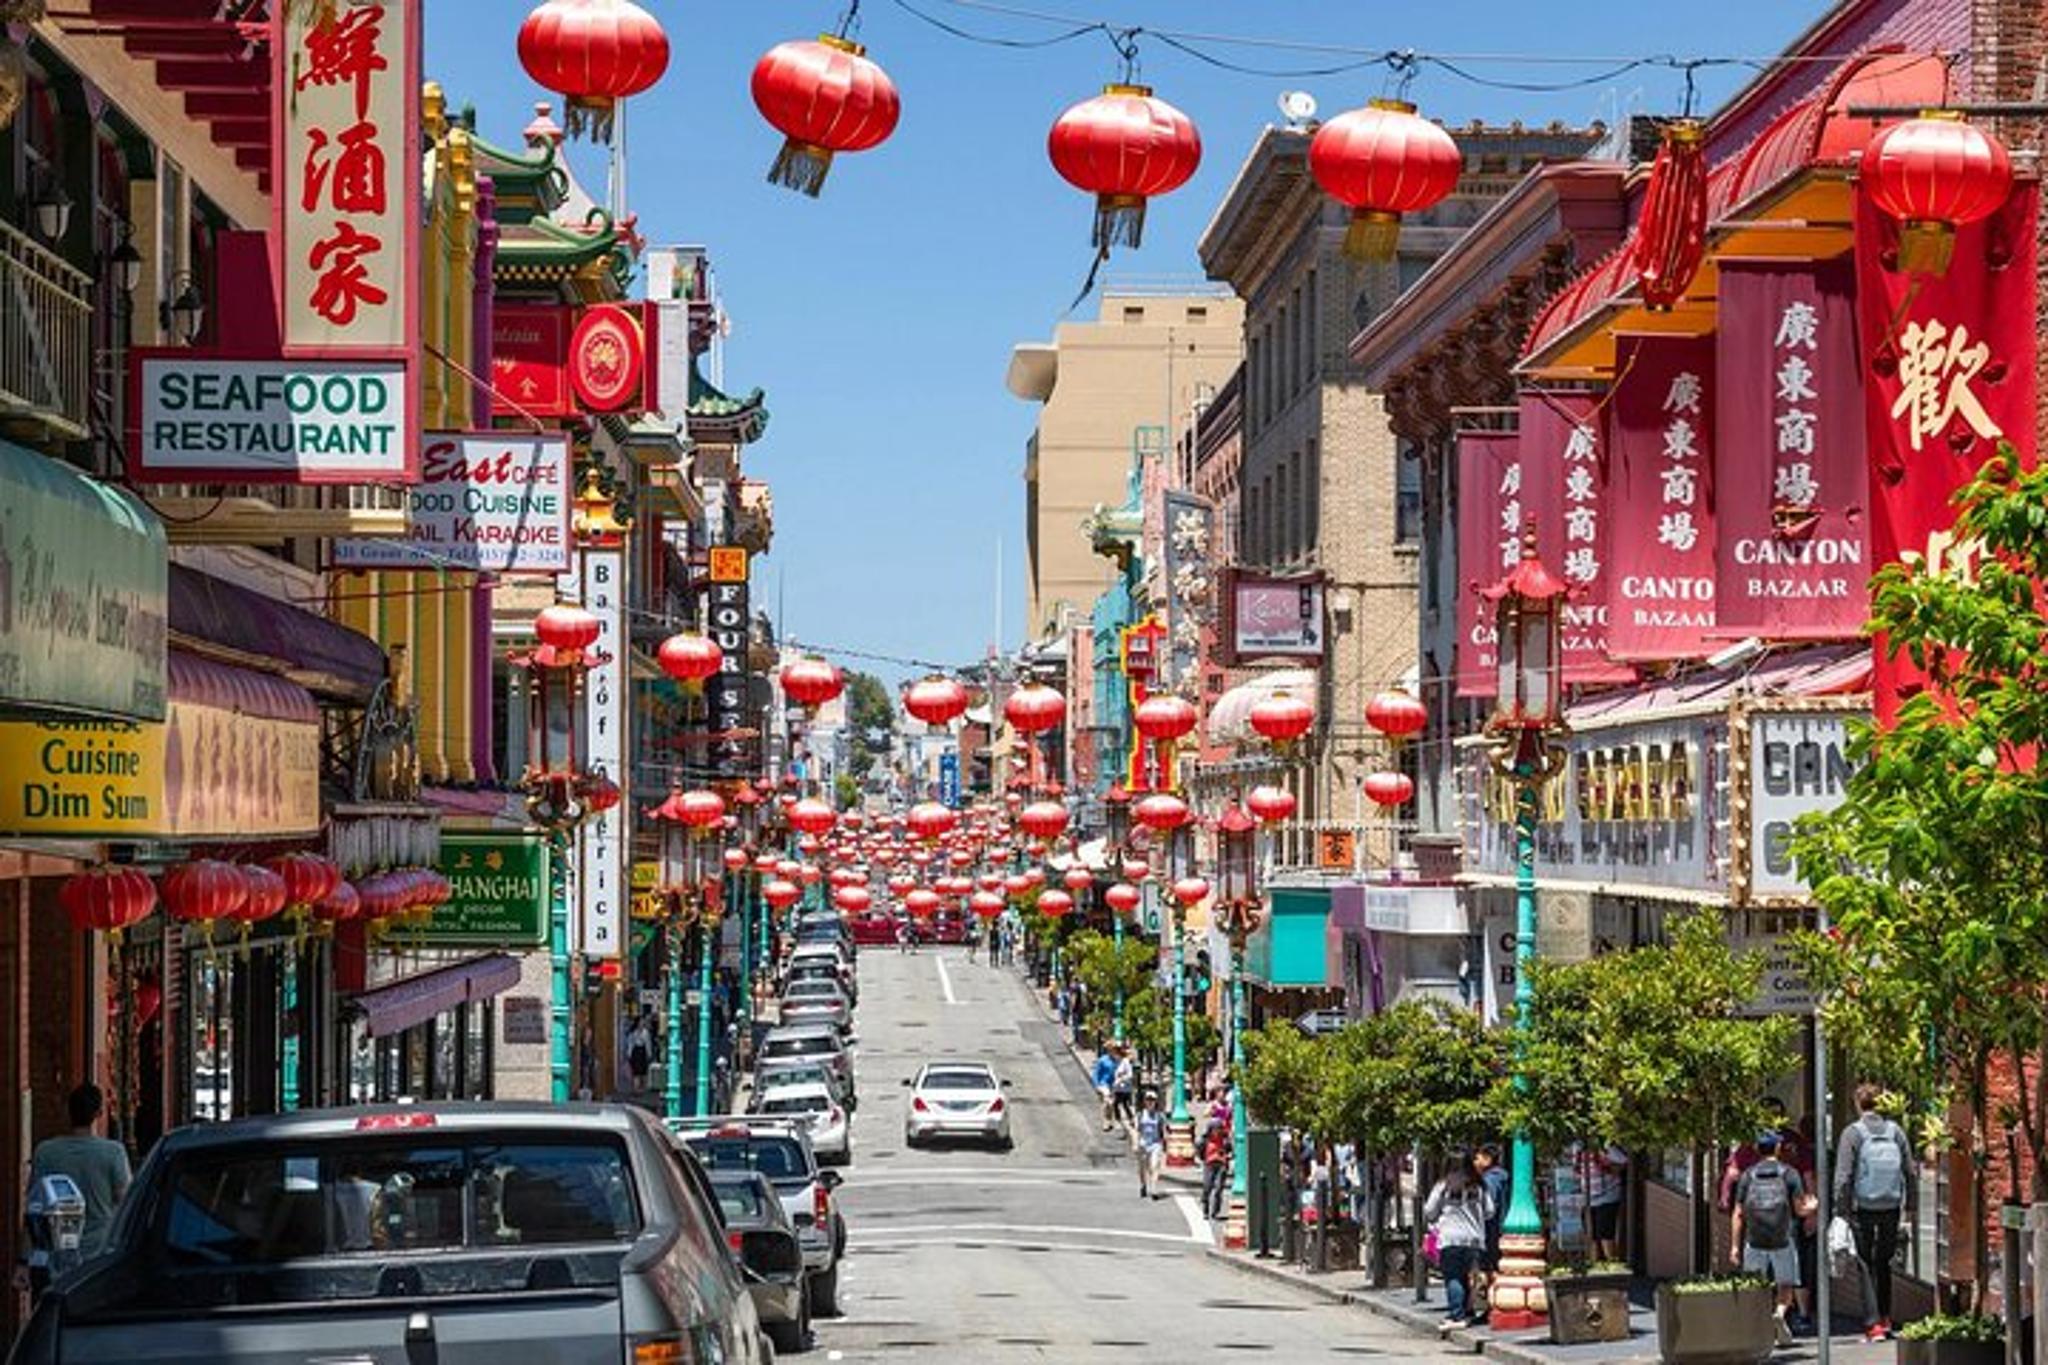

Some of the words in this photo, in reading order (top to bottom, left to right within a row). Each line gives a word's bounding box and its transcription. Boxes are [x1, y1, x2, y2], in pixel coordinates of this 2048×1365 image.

[159, 373, 388, 414] SEAFOOD
[1774, 301, 1819, 506] 廣東商場
[154, 421, 396, 455] RESTAURANT
[422, 441, 513, 484] East
[512, 461, 559, 485] CAFÉ
[1658, 370, 1702, 551] 廣東商場
[1734, 539, 1861, 565] CANTON
[1621, 576, 1714, 601] CANTO
[1747, 579, 1849, 597] BAZAAR
[717, 585, 741, 672] FOUR
[42, 738, 140, 777] Cuisine
[23, 783, 89, 818] Dim
[102, 784, 149, 820] Sum
[446, 875, 539, 900] HANGHAI
